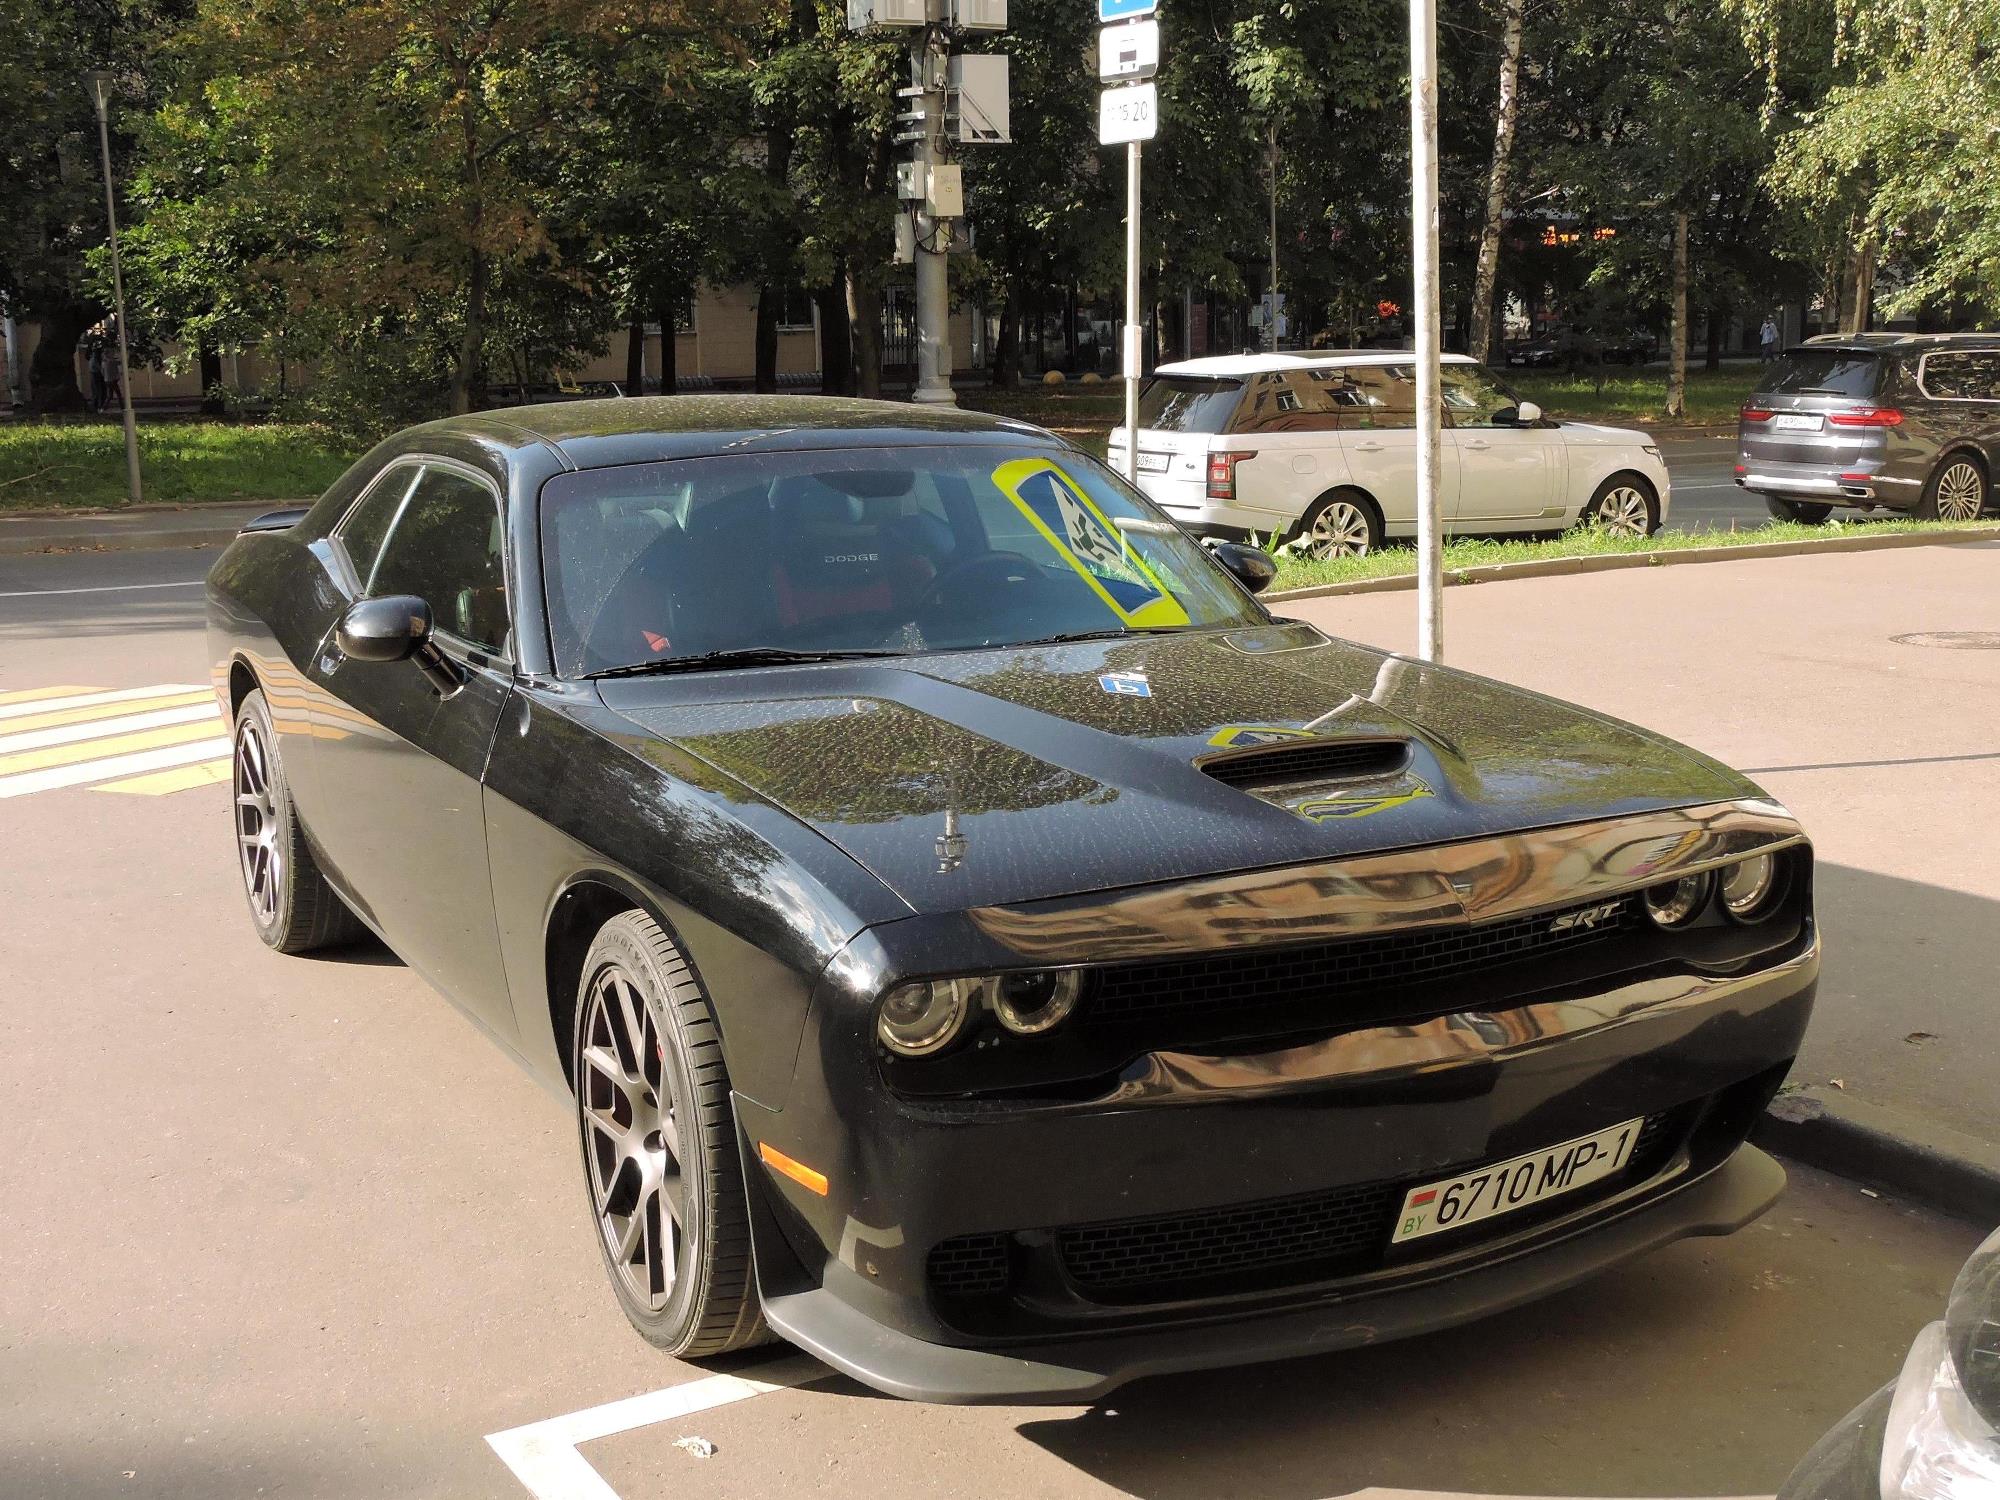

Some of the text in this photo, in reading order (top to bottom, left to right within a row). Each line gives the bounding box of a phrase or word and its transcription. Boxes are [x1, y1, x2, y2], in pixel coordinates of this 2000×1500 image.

[1132, 100, 1148, 122] 20
[824, 553, 880, 563] DODGE
[1550, 902, 1621, 932] SRT
[1436, 1128, 1631, 1225] 6710 MP-1
[1402, 1214, 1428, 1235] BY
